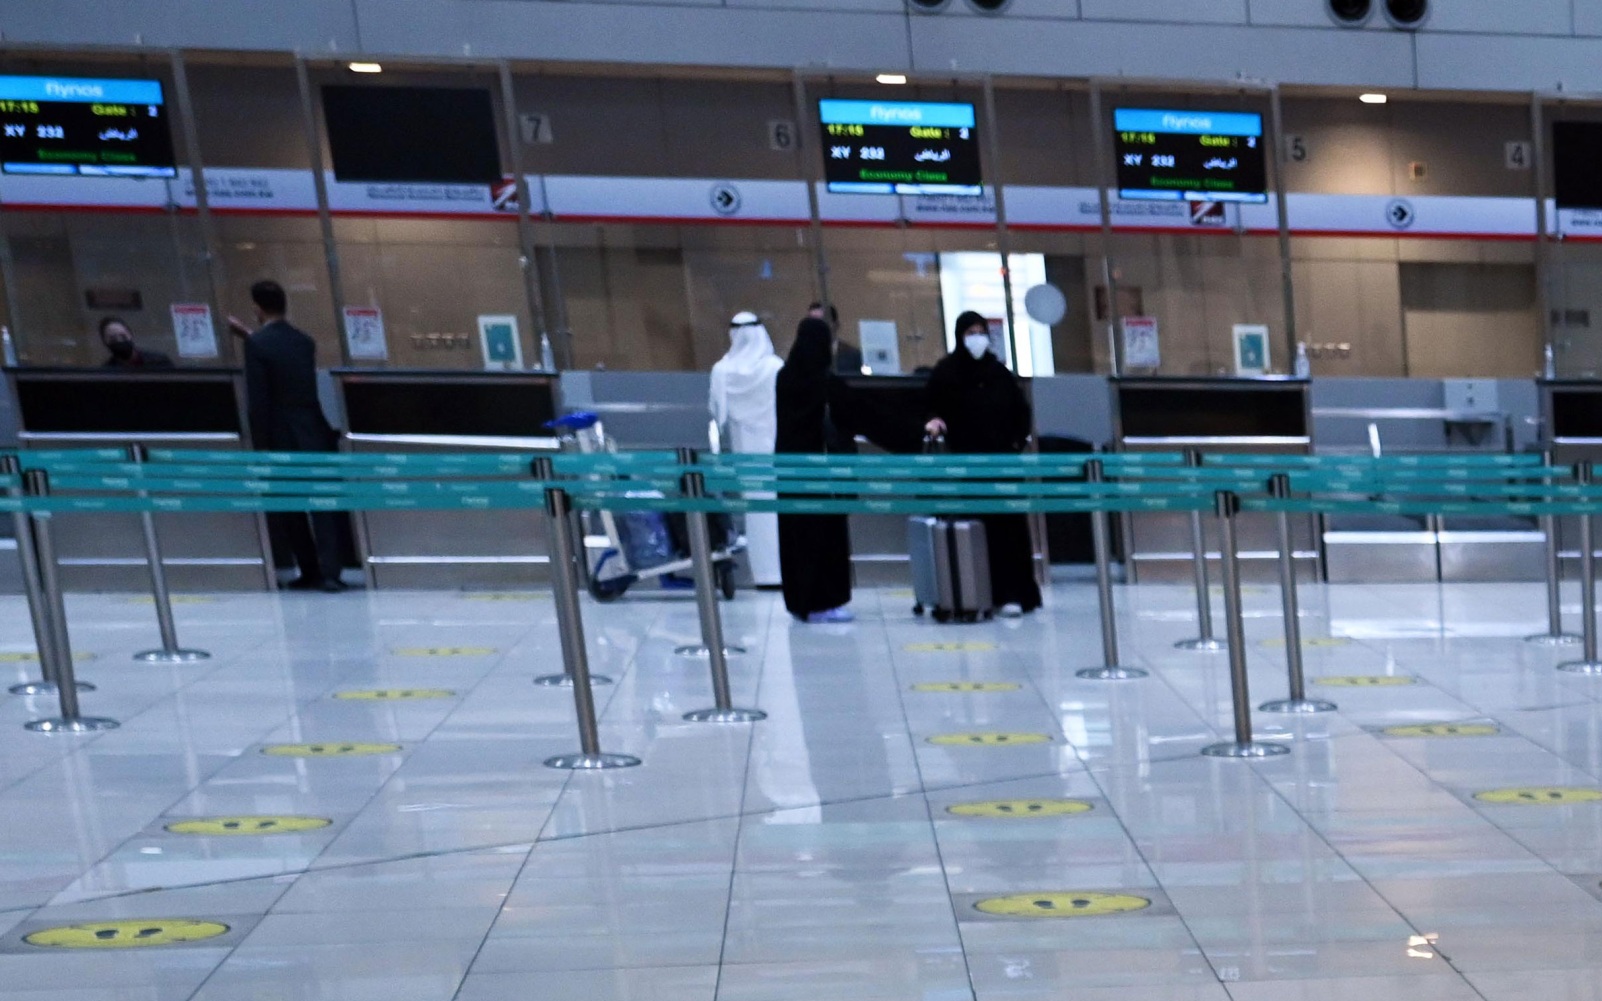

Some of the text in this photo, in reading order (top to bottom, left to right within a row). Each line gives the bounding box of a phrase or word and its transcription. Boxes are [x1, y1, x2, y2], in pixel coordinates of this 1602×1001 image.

[527, 116, 540, 140] 7
[775, 124, 790, 149] 6
[1292, 137, 1306, 160] 5
[1511, 145, 1523, 165] 4
